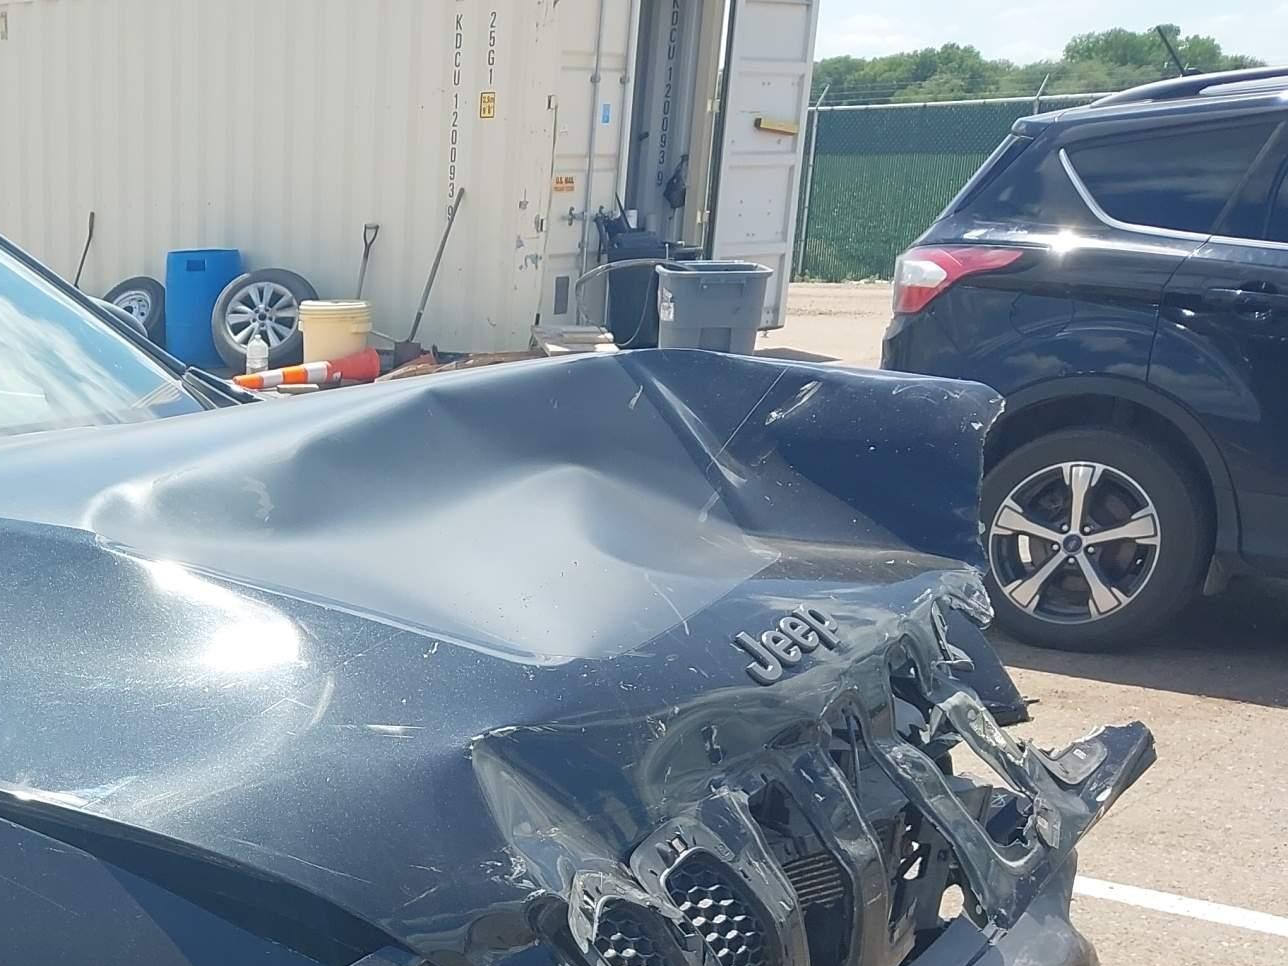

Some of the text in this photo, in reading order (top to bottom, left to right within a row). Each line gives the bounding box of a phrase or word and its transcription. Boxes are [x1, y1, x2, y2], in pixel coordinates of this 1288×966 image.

[452, 13, 464, 87] KDCU
[487, 11, 497, 86] 25G1
[448, 92, 460, 199] 120093
[732, 606, 840, 687] Jeep
